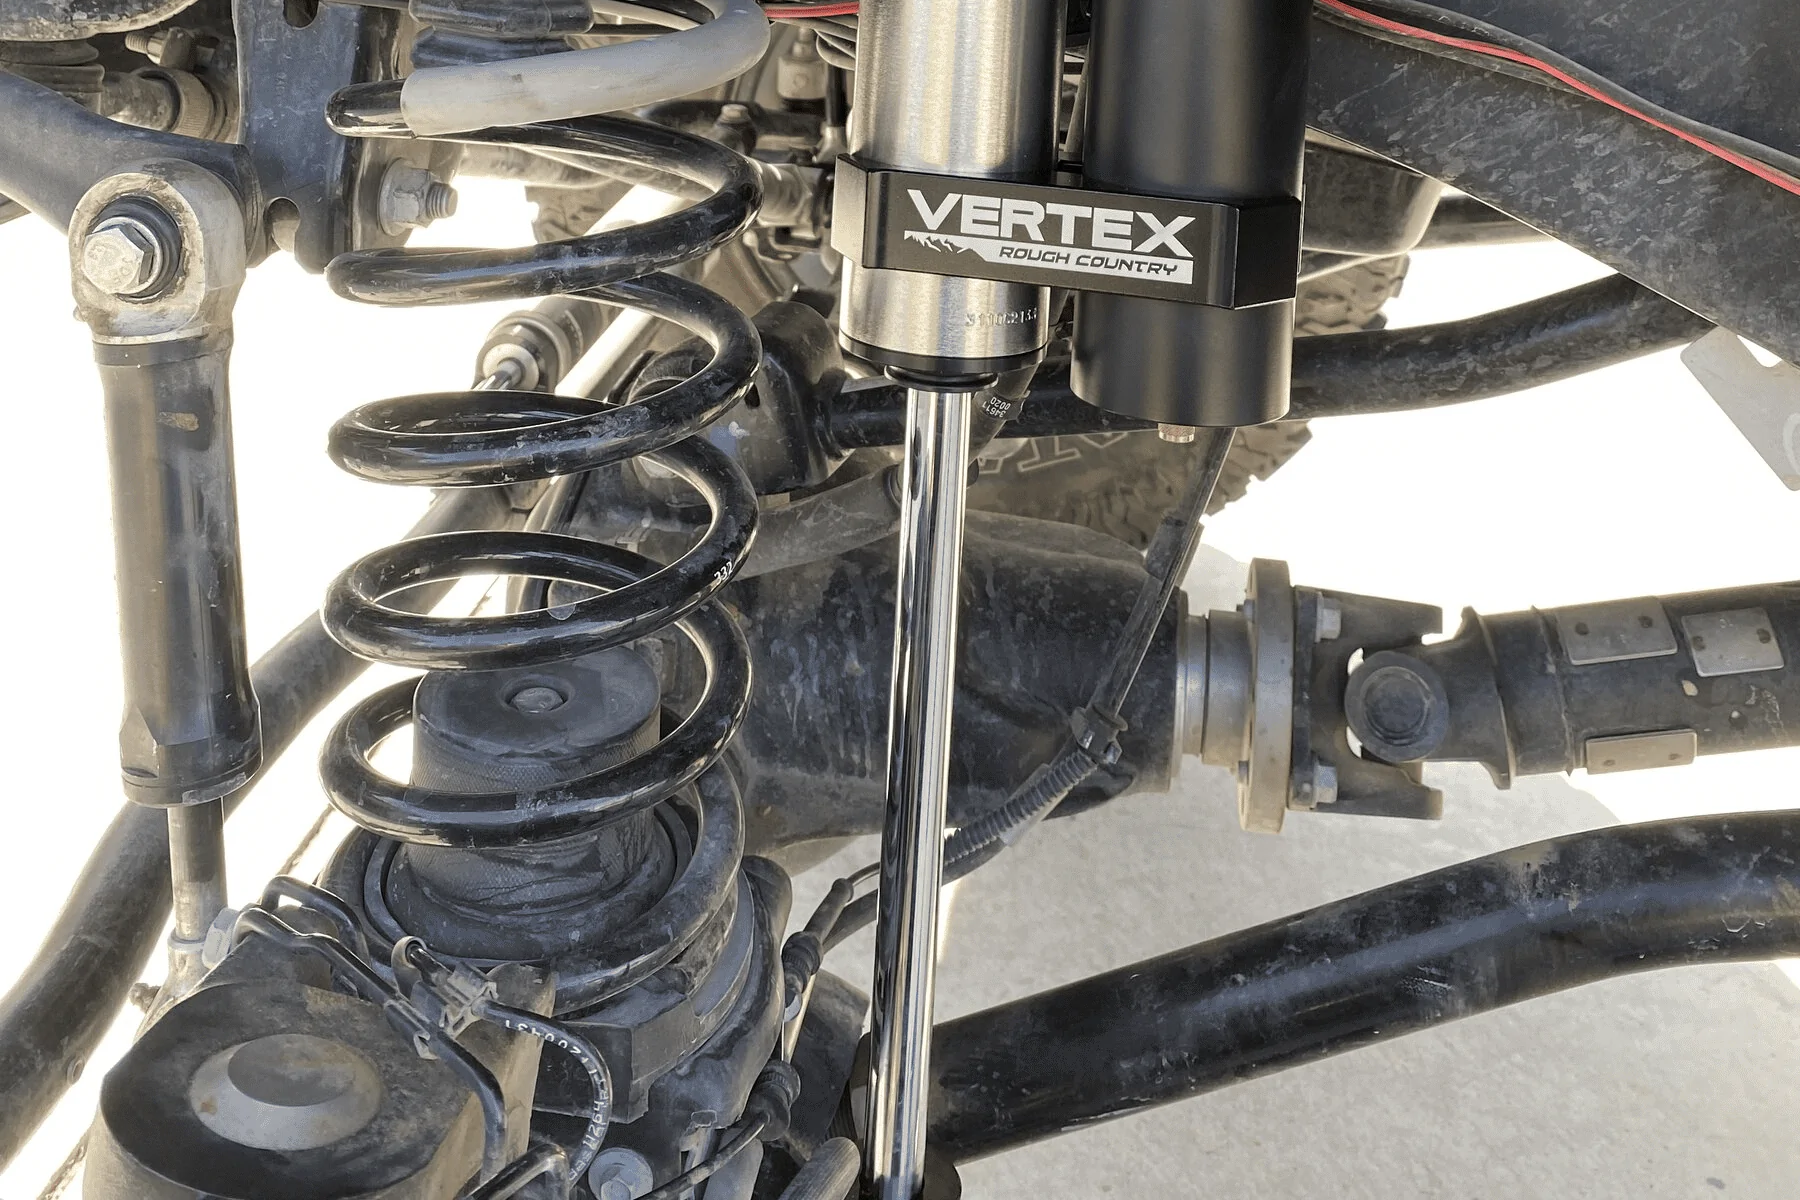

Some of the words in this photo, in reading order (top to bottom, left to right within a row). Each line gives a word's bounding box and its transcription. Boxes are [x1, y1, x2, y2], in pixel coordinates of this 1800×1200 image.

[907, 188, 1196, 258] VERTEX
[999, 246, 1070, 265] ROUGH
[1075, 254, 1178, 276] COUNTRY
